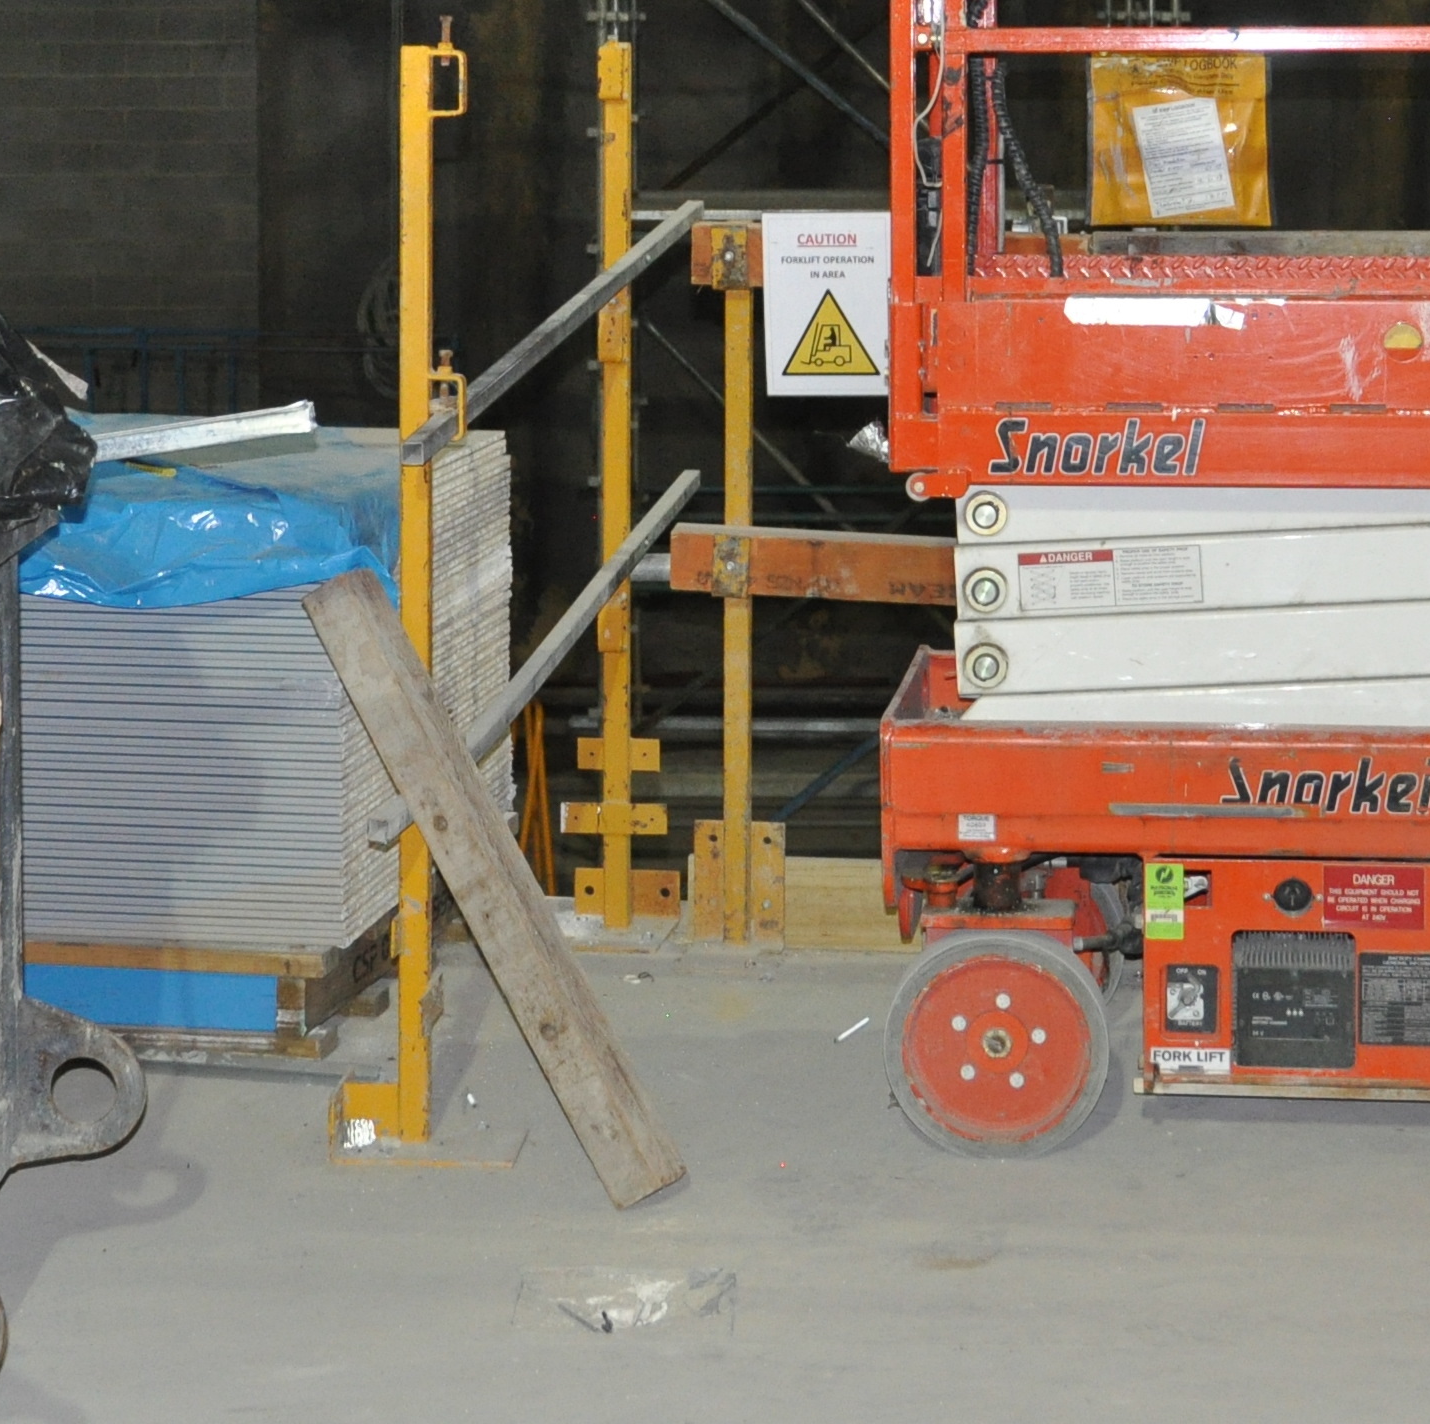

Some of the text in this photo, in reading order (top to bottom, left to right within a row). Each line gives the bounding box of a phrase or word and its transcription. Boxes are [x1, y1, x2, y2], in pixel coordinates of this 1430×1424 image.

[797, 233, 858, 246] CAUTION
[781, 255, 875, 265] FORKLIFT OPERATION
[810, 270, 846, 279] IN AREA
[988, 417, 1206, 475] Snorkel
[1048, 551, 1093, 563] DANGER
[1352, 873, 1395, 885] DANGER
[1390, 897, 1421, 905] CHARGING
[1153, 1049, 1226, 1063] FORK LIFT
